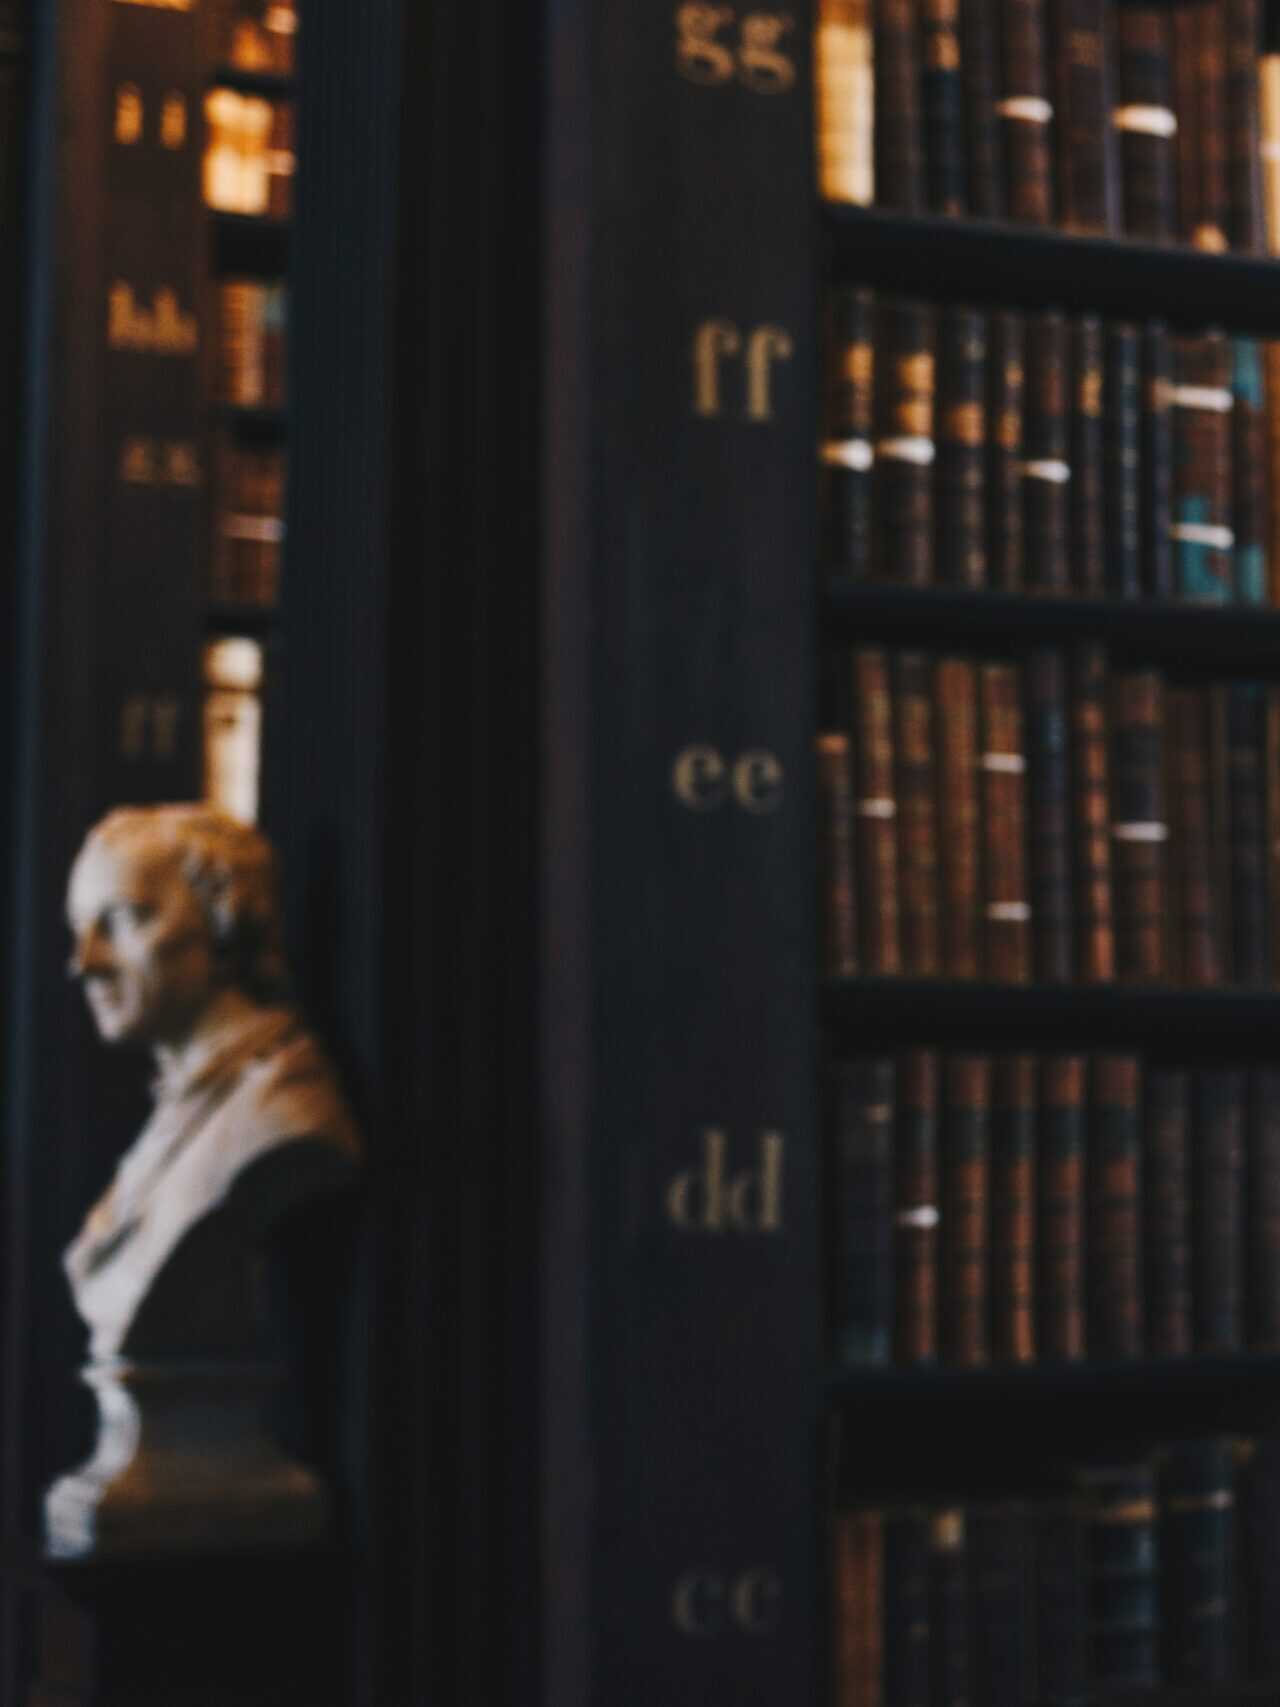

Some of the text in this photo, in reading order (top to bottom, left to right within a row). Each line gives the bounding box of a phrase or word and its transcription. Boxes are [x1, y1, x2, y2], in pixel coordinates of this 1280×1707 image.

[676, 1, 796, 92] gg
[694, 319, 794, 421] ff
[671, 744, 784, 812] ee
[664, 1127, 785, 1233] dd
